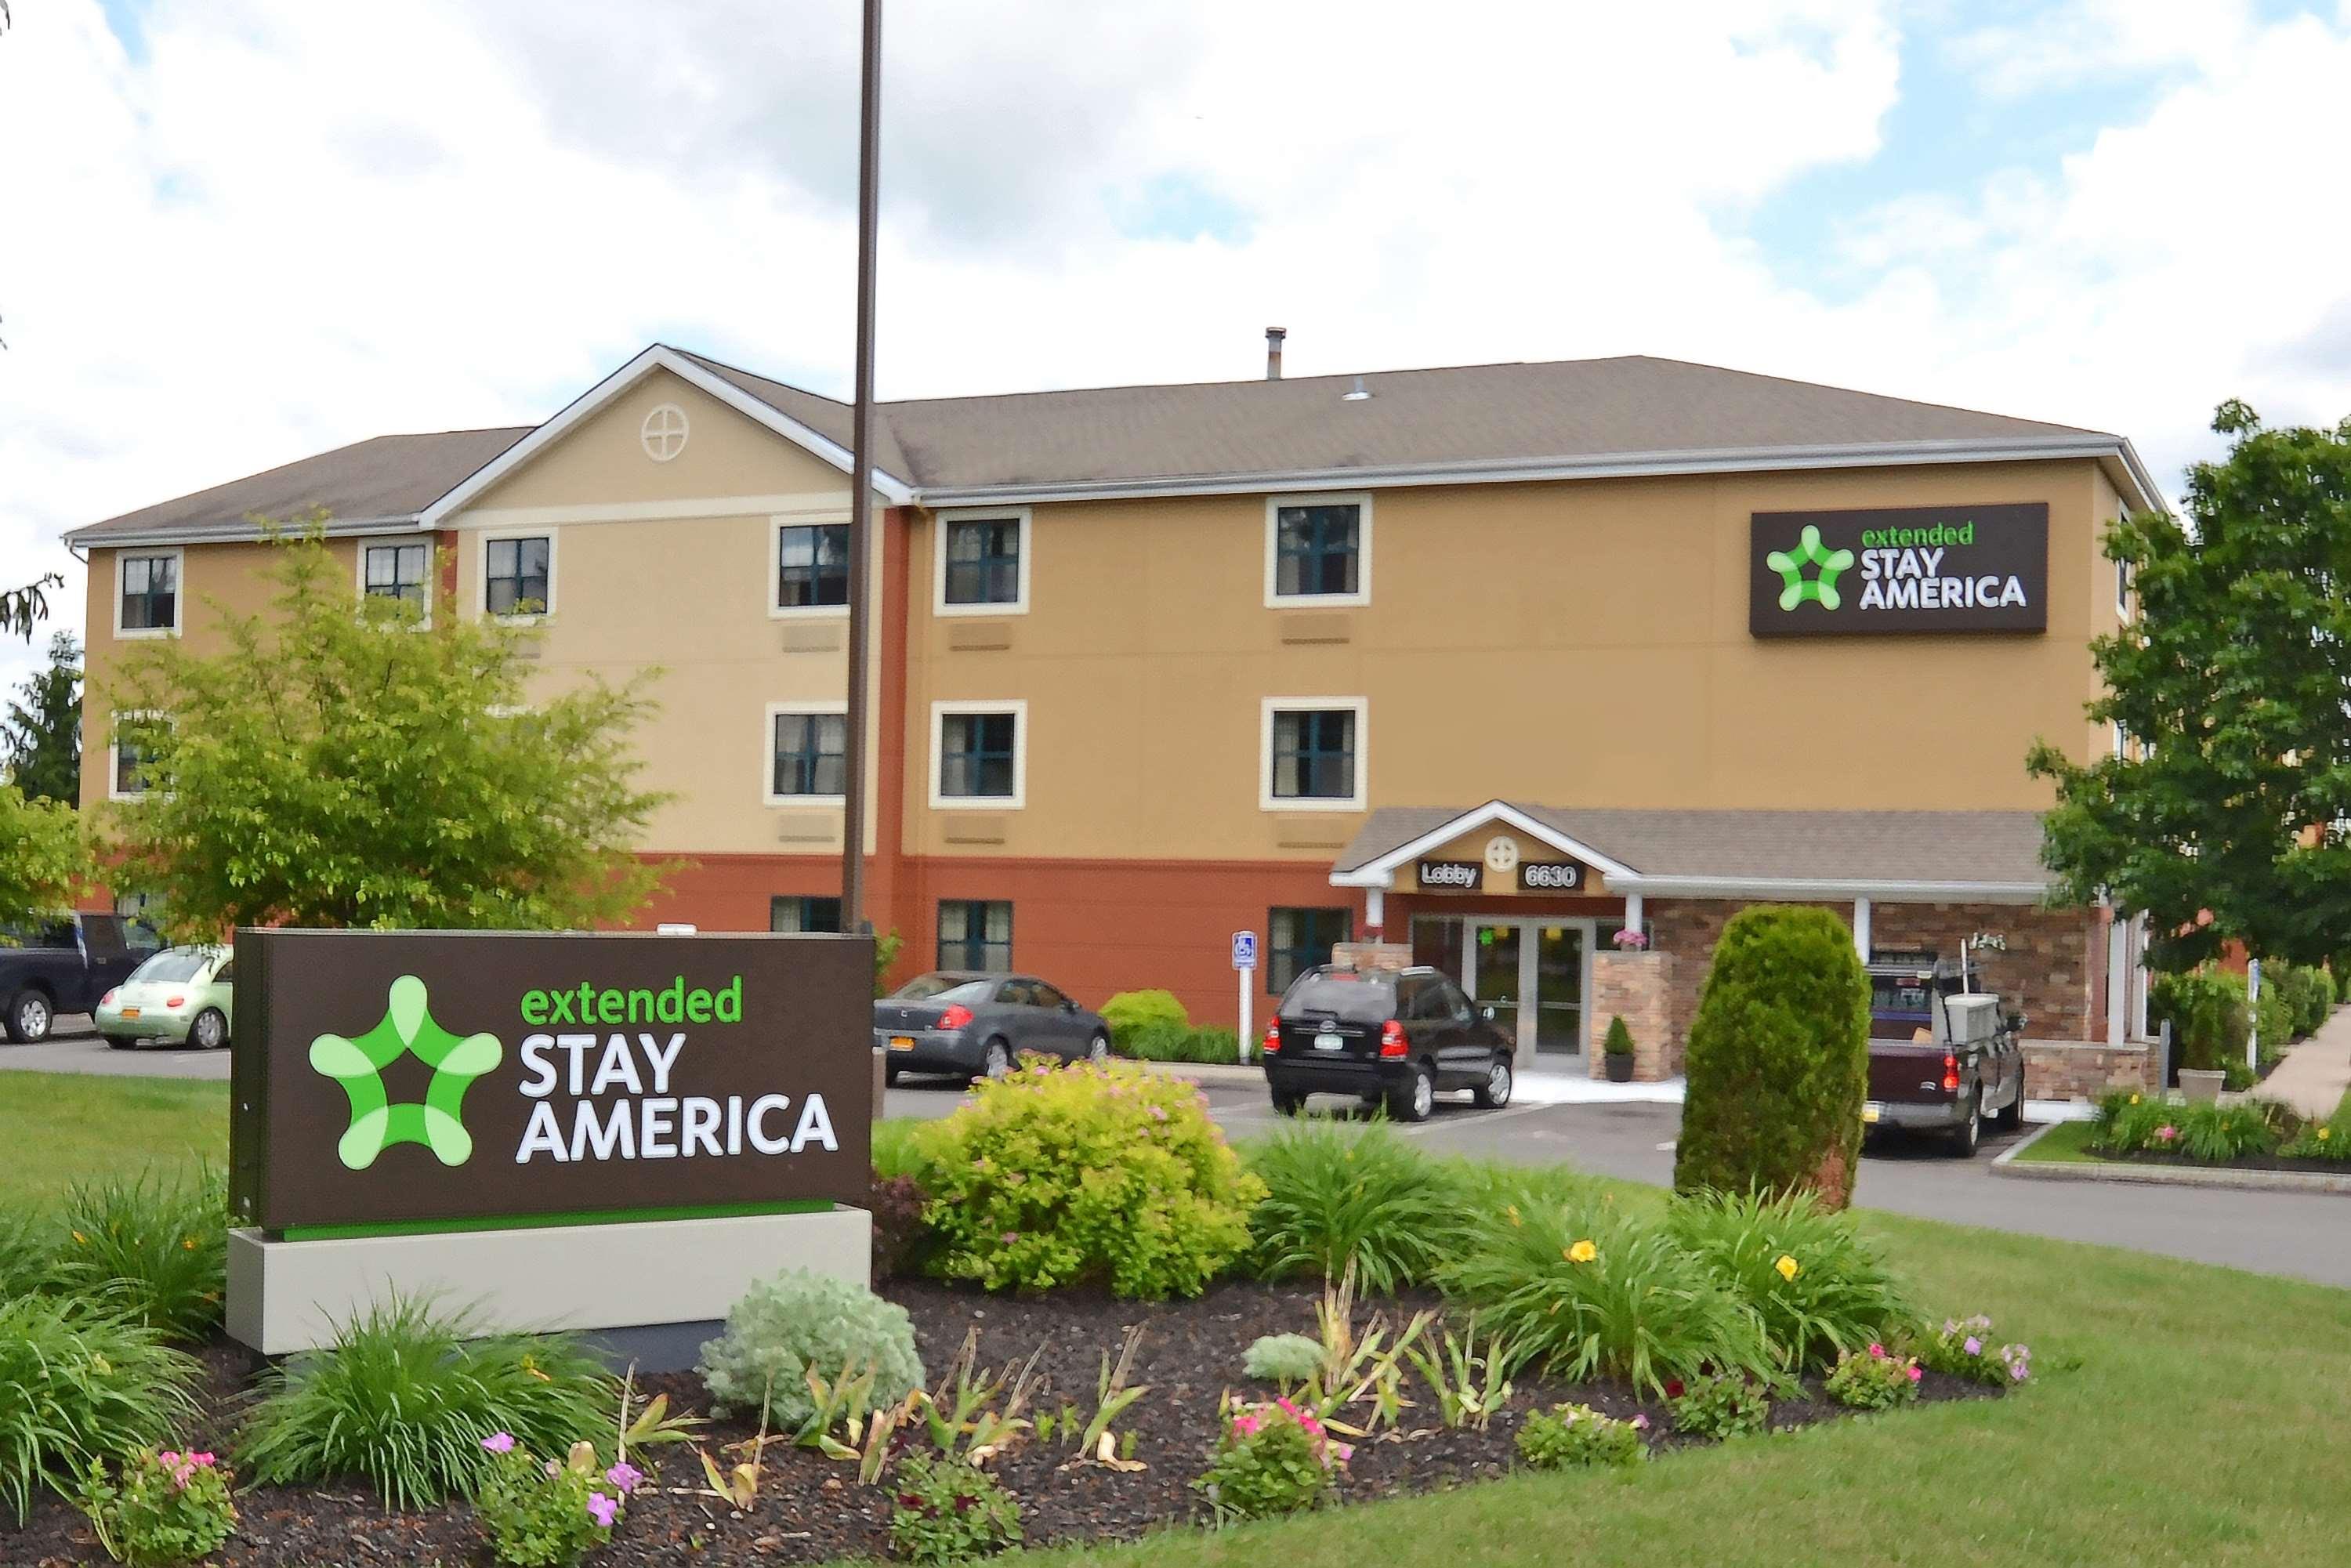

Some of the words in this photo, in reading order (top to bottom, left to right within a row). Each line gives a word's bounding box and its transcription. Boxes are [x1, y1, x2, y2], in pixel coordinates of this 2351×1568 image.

[1862, 521, 1973, 547] extended
[1860, 548, 1944, 580] STAY
[1860, 575, 2027, 610] AMERICA
[1422, 864, 1476, 888] Lobby
[1525, 865, 1577, 887] 6630
[521, 975, 742, 1024] extended
[519, 1033, 686, 1097] STAY
[515, 1094, 839, 1164] AMERICA
